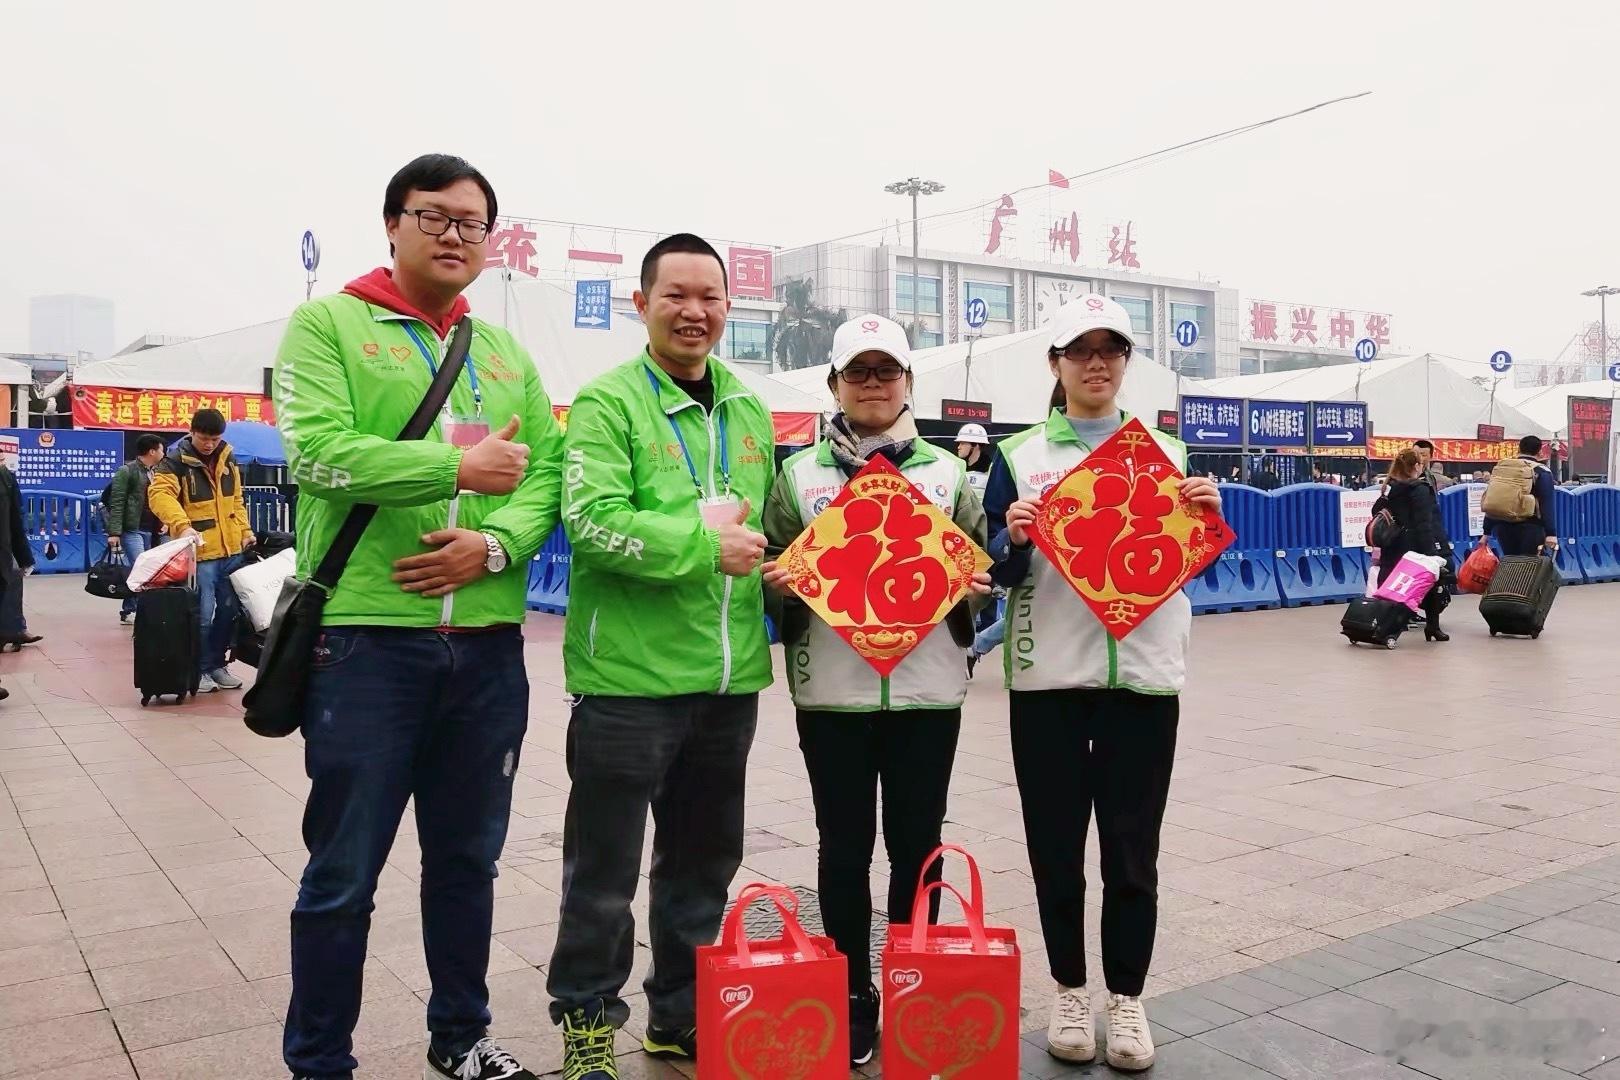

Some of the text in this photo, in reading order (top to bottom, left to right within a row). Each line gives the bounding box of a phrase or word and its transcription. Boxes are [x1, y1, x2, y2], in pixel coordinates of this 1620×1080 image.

[984, 194, 1140, 268] 广州站
[968, 302, 984, 325] 12
[1178, 324, 1193, 344] 11
[1250, 302, 1390, 351] 振兴中华
[1358, 341, 1374, 360] 10
[1496, 353, 1506, 368] 9
[1117, 430, 1151, 451] 平
[860, 478, 902, 493] 恭喜发财
[1063, 472, 1184, 597] 福
[816, 493, 950, 626] 福
[1104, 600, 1140, 627] 安
